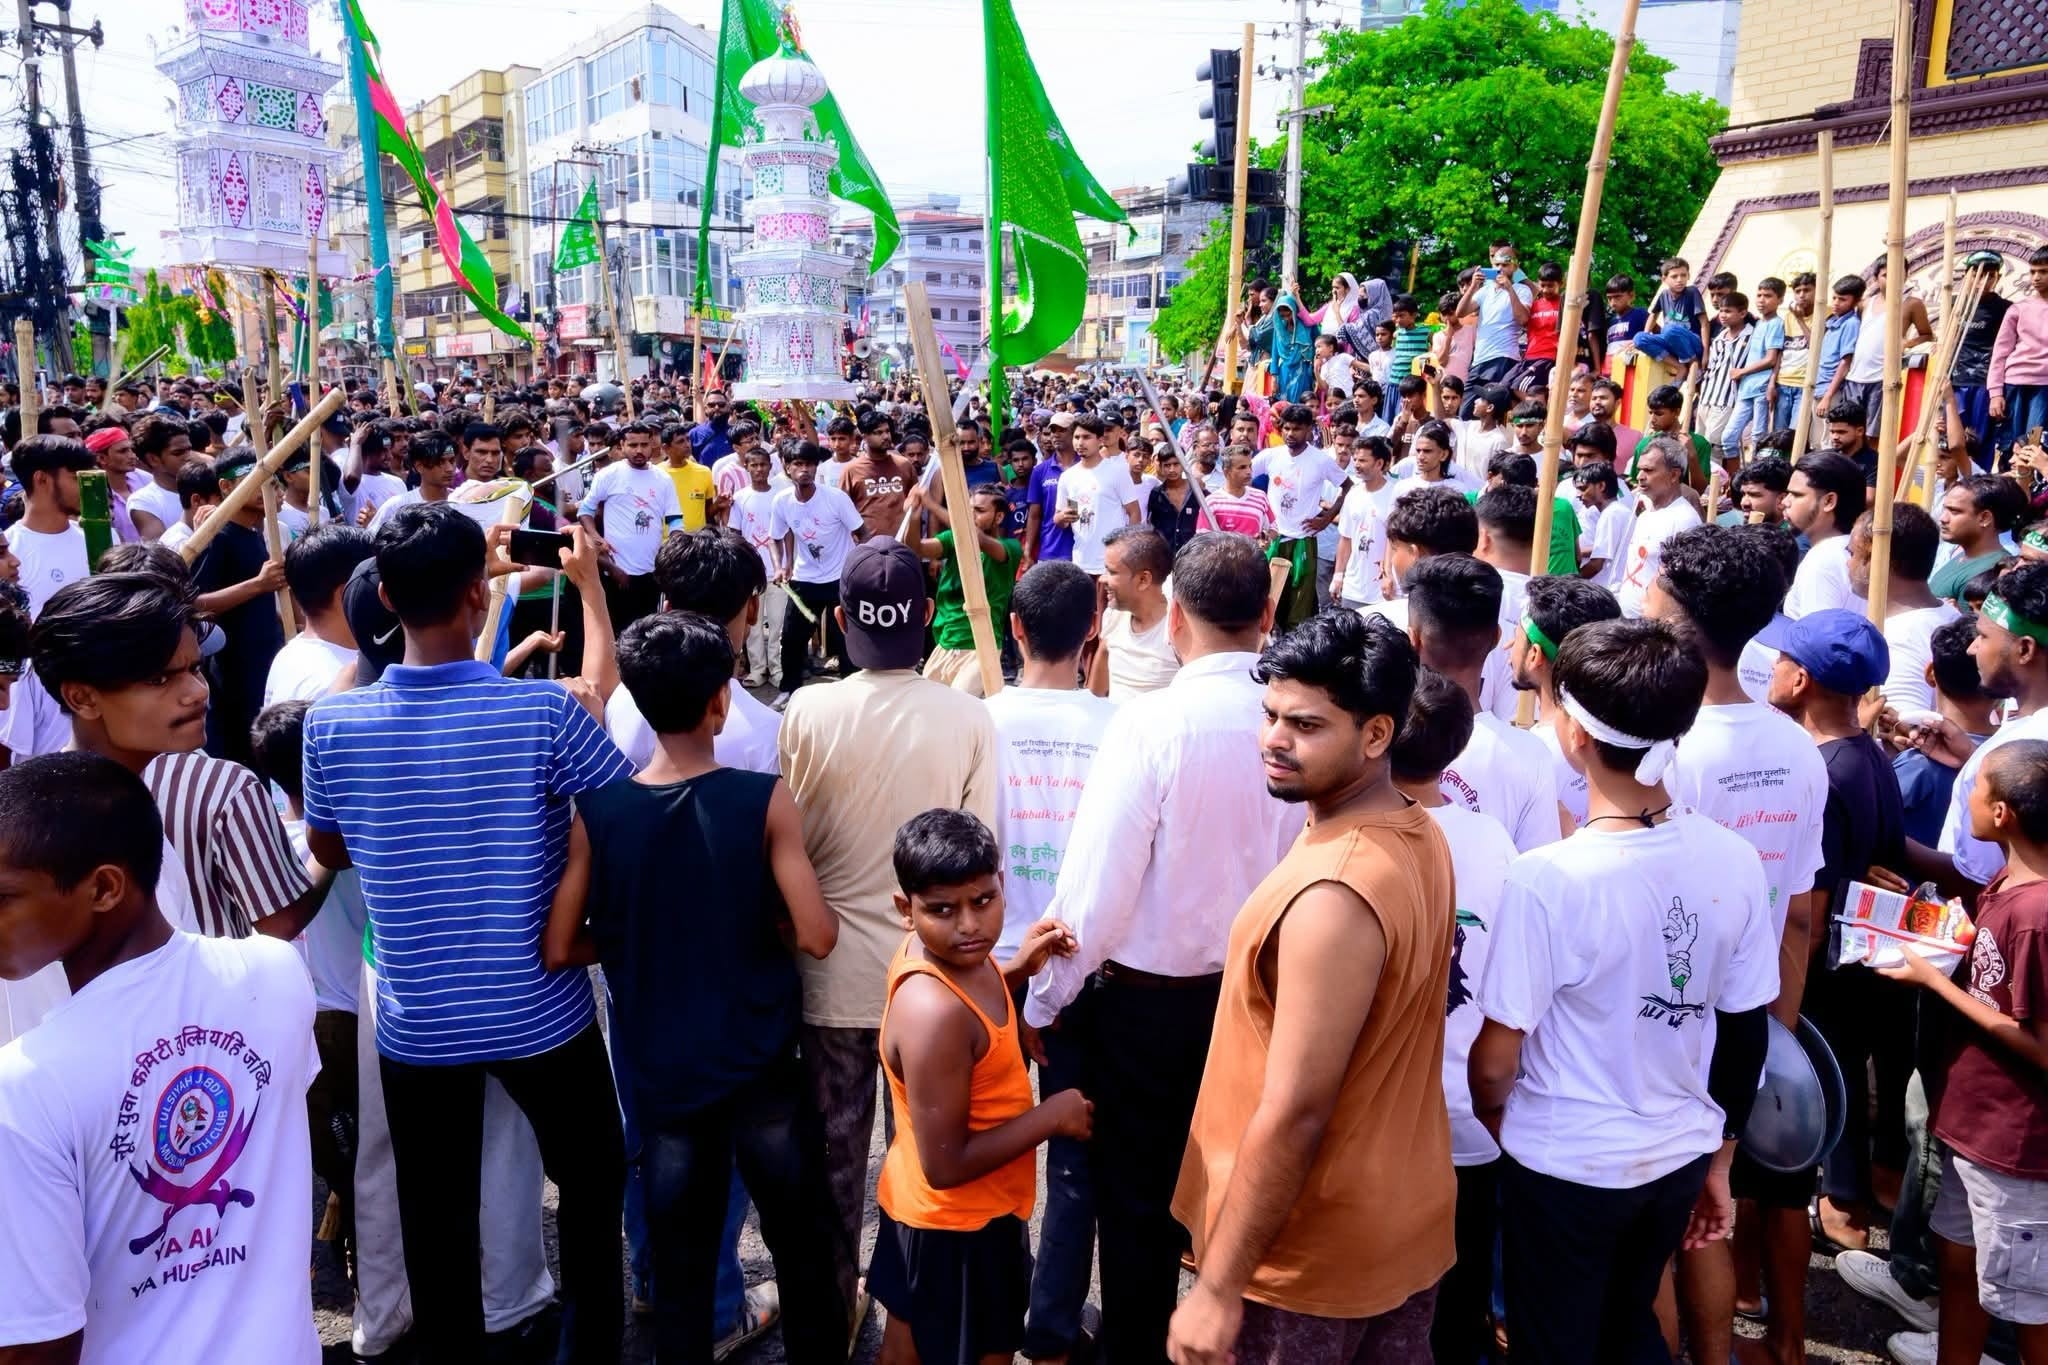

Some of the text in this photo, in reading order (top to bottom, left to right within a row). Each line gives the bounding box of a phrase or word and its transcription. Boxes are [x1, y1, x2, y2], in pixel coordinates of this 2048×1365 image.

[858, 599, 912, 628] BOY
[1008, 775, 1021, 787] Ya
[210, 1109, 229, 1140] CLUB
[154, 1233, 183, 1262] YA
[131, 1276, 157, 1298] YA
